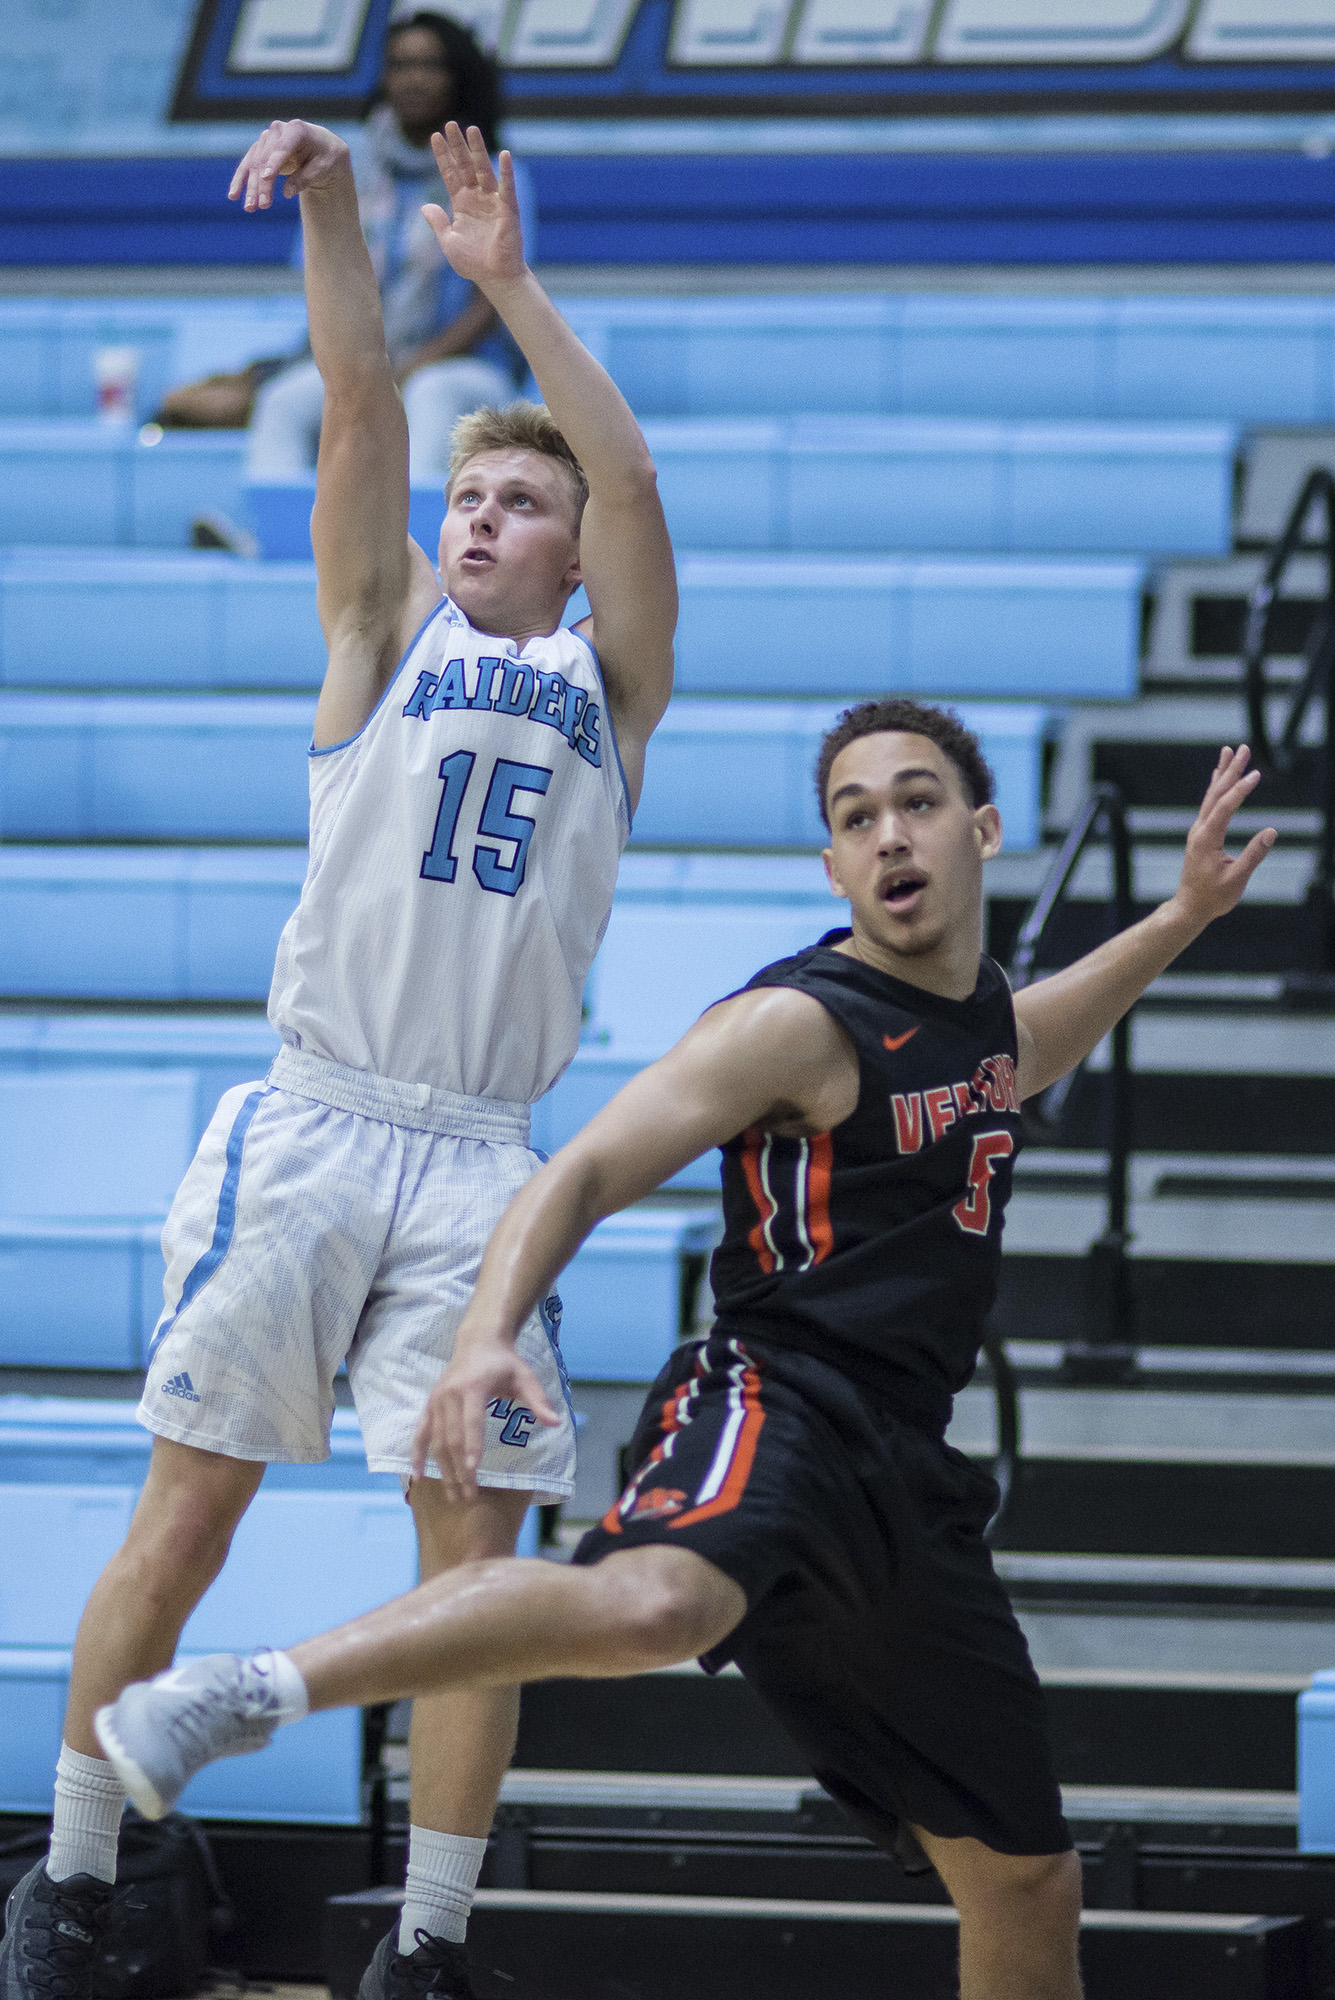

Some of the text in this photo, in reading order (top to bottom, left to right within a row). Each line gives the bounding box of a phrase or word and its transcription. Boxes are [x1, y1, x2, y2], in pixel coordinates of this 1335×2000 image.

[402, 656, 602, 768] RAIDERS
[419, 749, 554, 898] 15
[952, 1129, 1014, 1236] 5
[161, 1384, 200, 1403] adidas
